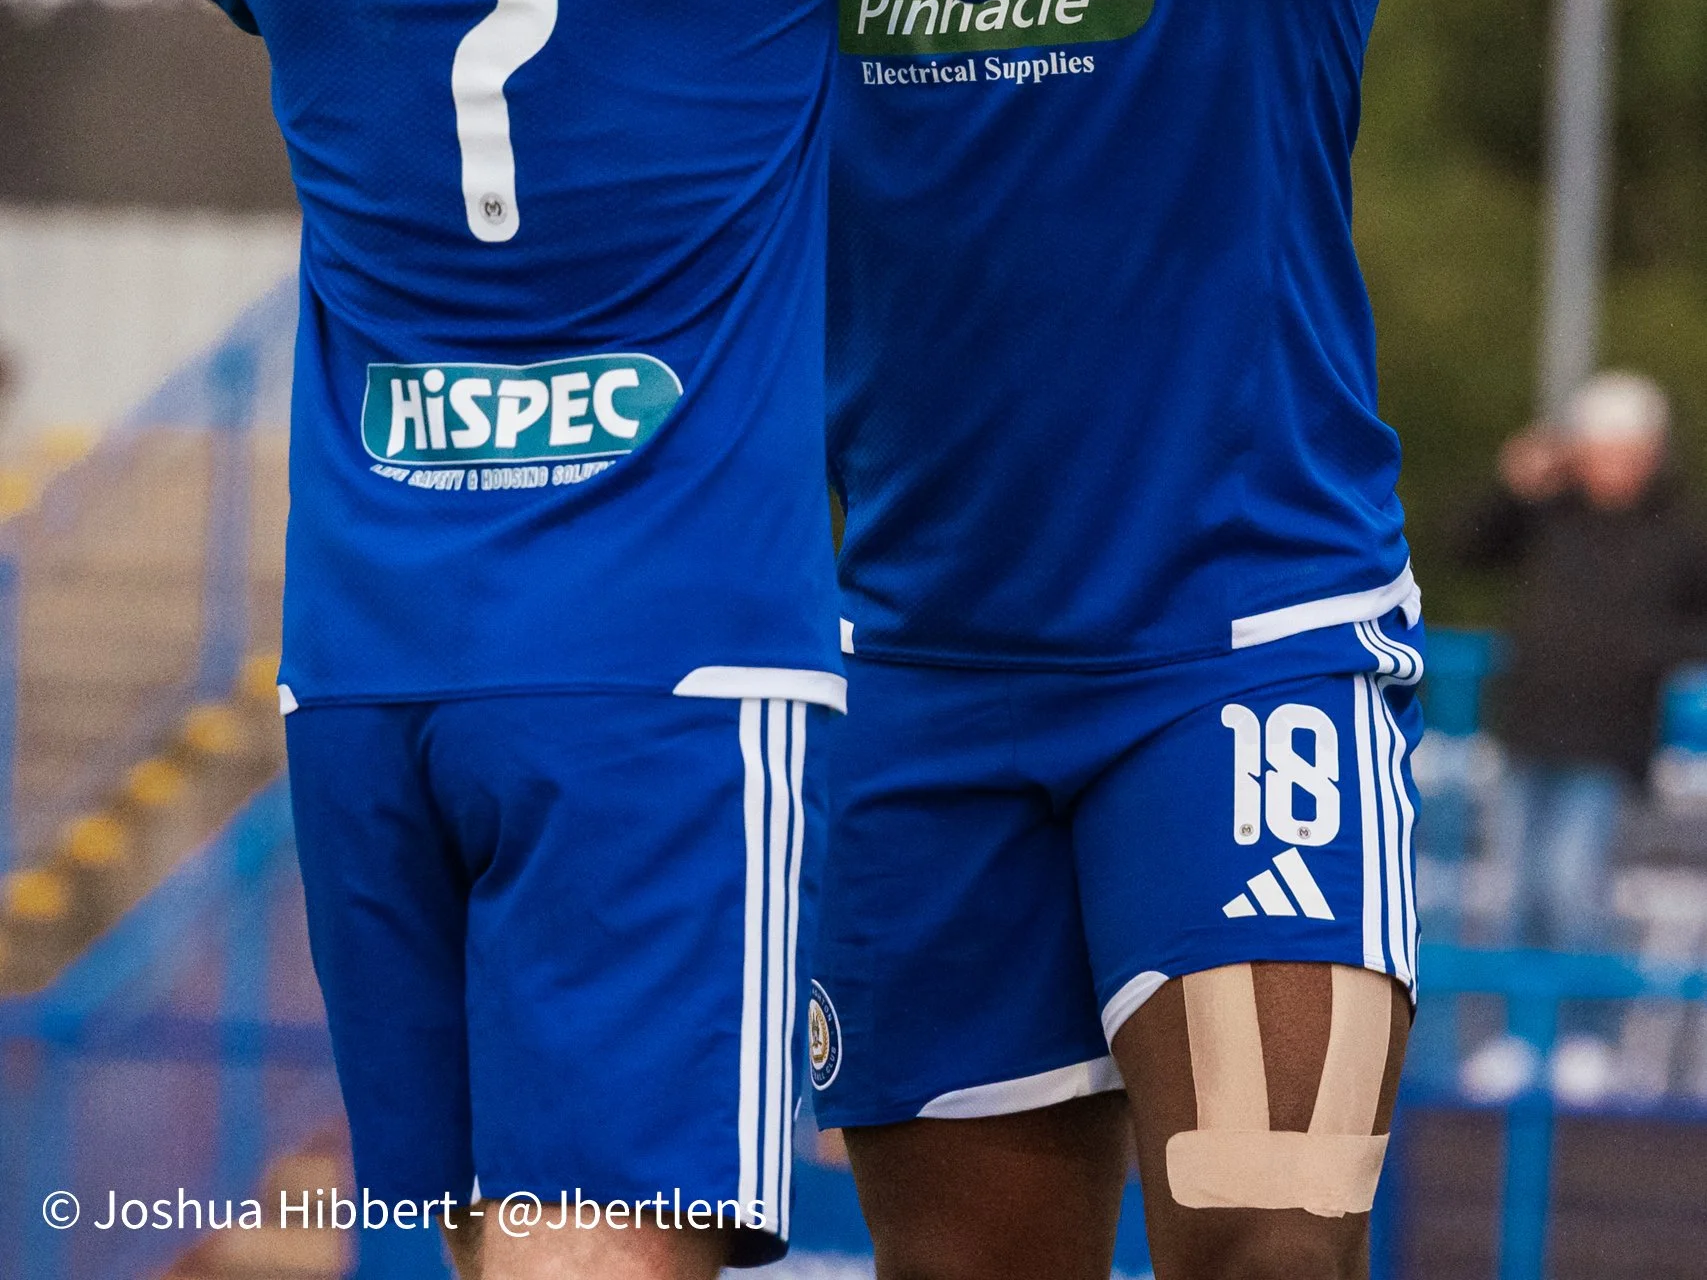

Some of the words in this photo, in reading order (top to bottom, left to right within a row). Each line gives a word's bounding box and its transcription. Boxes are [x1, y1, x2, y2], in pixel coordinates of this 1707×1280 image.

[861, 59, 977, 85] Electrical
[984, 51, 1095, 84] Supplies
[481, 466, 549, 491] HOUSING
[1221, 703, 1340, 846] 18
